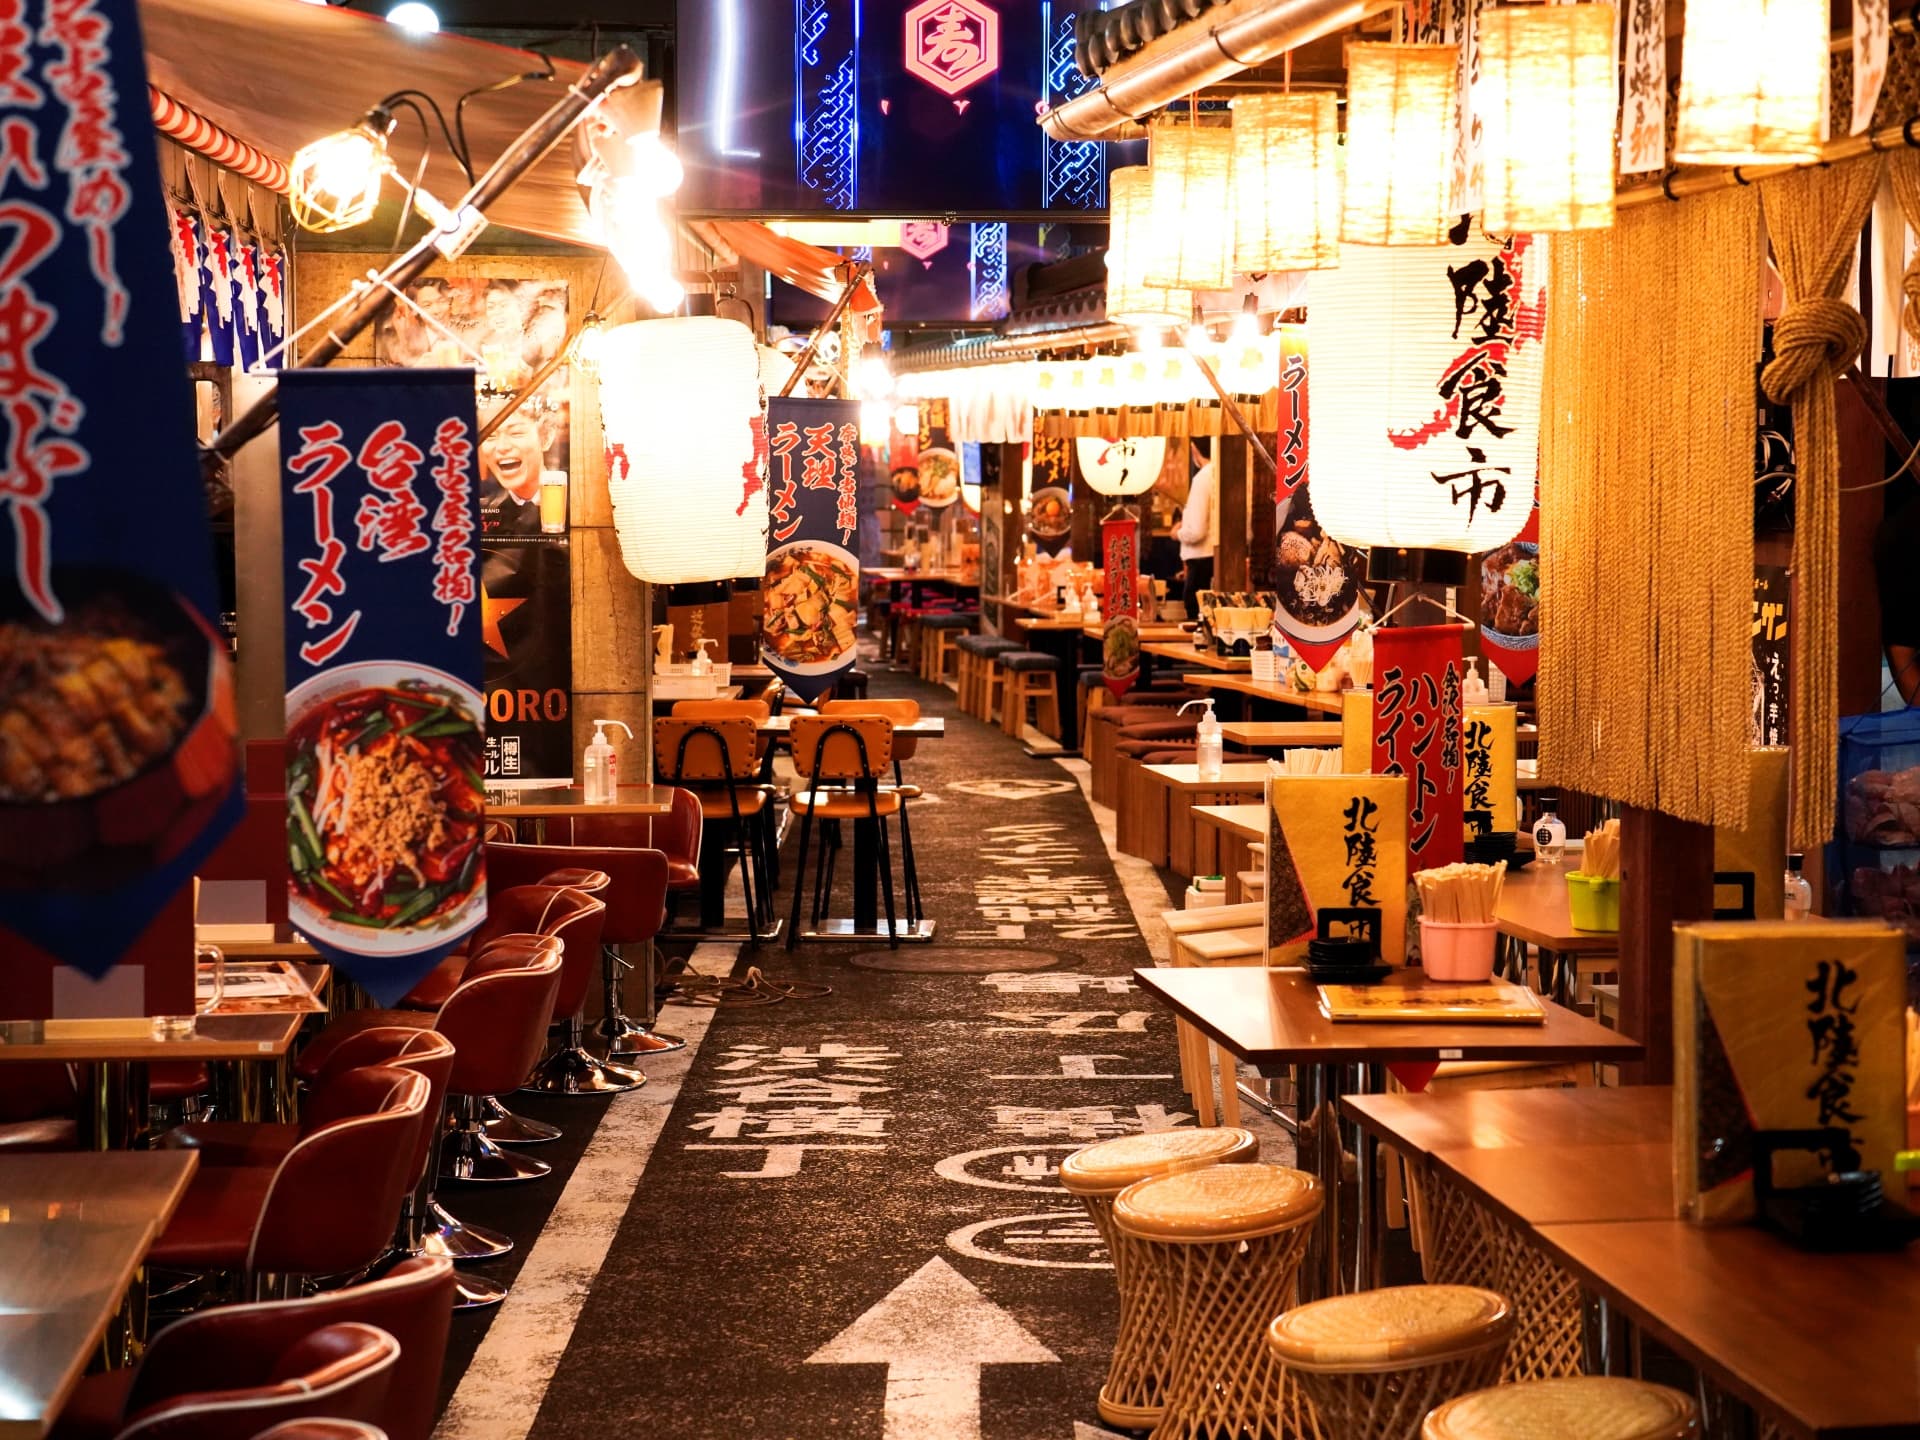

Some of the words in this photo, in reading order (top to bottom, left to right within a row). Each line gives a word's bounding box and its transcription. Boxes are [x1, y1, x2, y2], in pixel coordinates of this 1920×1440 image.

[770, 421, 803, 542] ラーメン
[801, 422, 837, 490] 天理
[1281, 354, 1308, 488] ラーメン
[287, 420, 362, 666] ラーメン
[355, 420, 431, 563] 台湾
[1406, 672, 1439, 855] ハントン
[684, 1043, 903, 1179] 渋谷横丁
